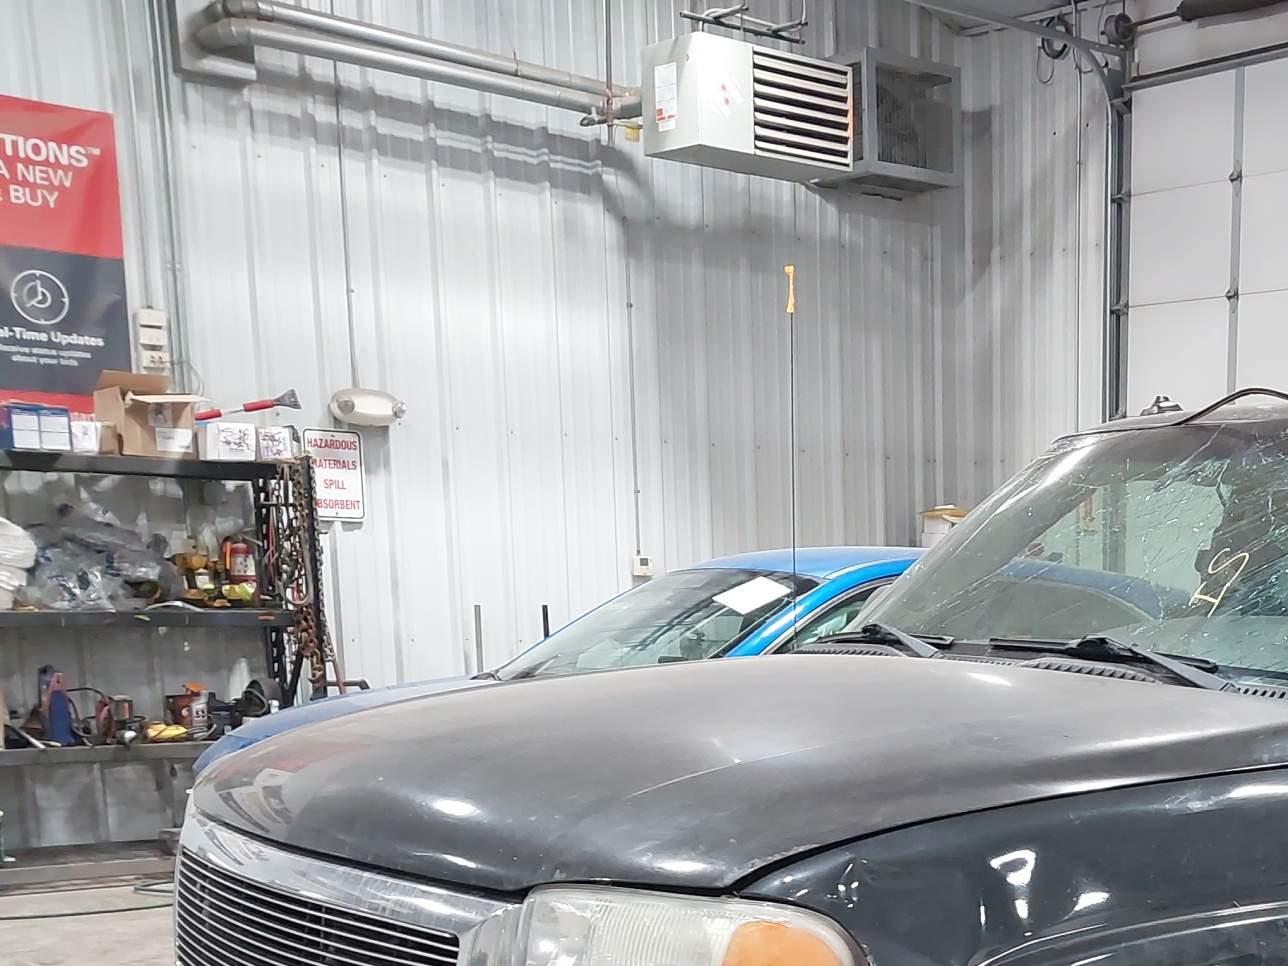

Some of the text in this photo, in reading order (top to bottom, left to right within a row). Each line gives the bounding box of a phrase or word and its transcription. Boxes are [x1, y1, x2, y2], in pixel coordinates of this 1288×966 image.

[17, 162, 73, 188] NEW
[9, 184, 59, 209] BUY
[50, 331, 105, 347] Updates
[306, 437, 358, 451] HAZARDOUS
[323, 478, 347, 490] SPILL
